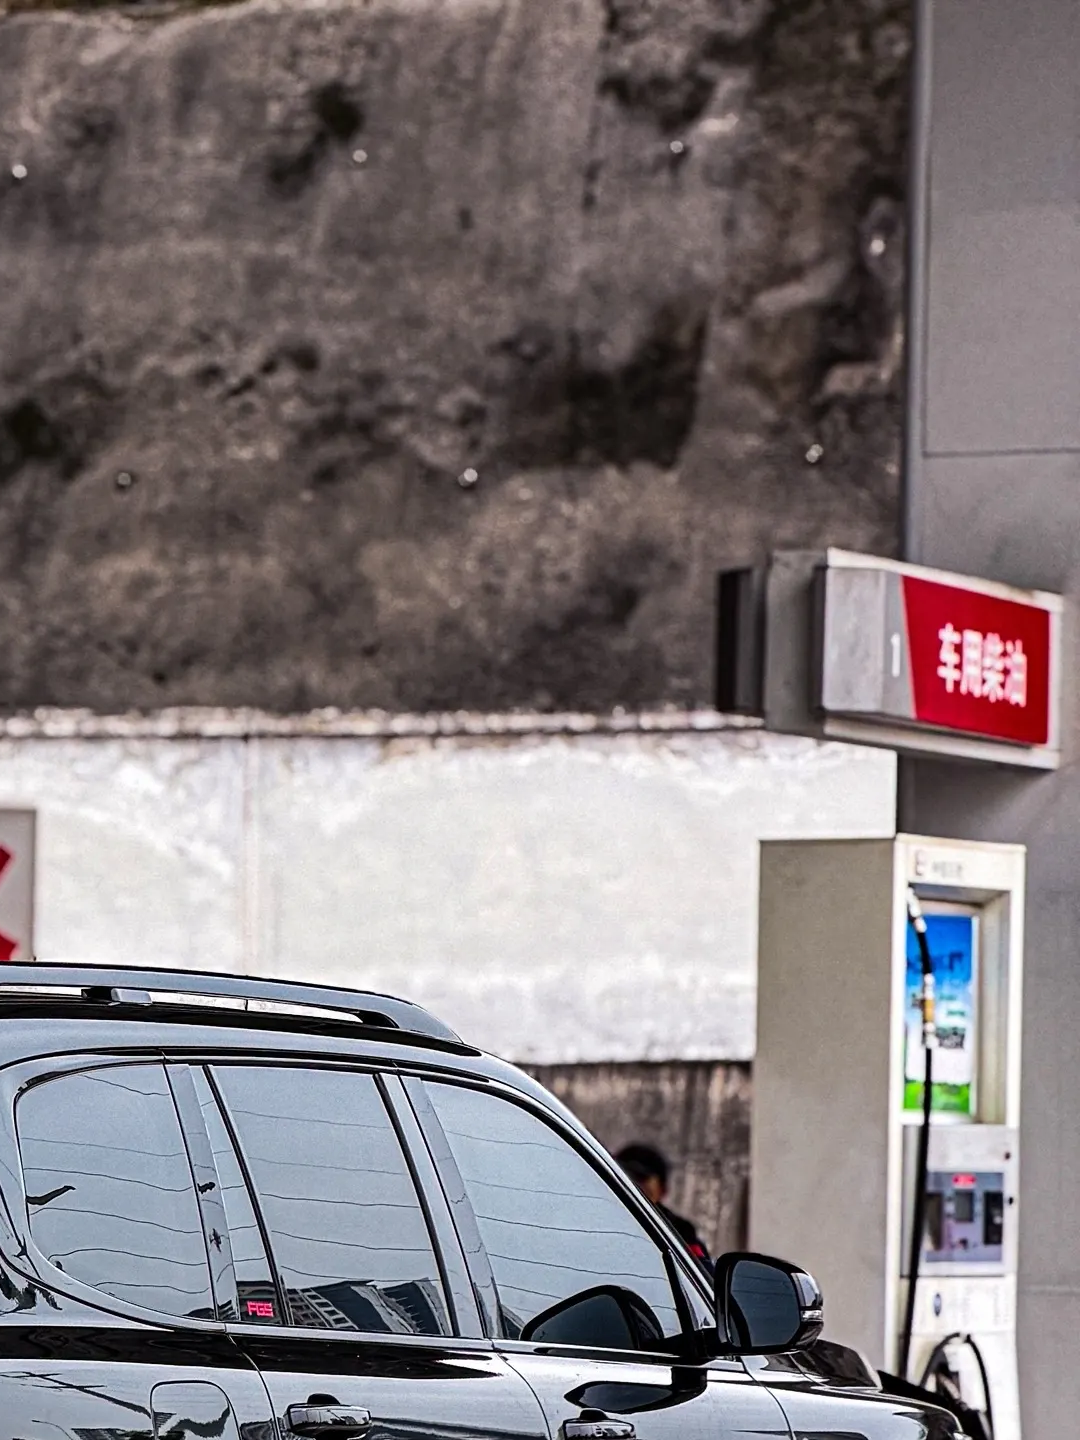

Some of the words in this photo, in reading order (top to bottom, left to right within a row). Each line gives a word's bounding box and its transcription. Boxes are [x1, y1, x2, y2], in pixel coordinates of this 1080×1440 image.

[890, 632, 901, 678] 1
[937, 622, 1028, 708] 车用柴油
